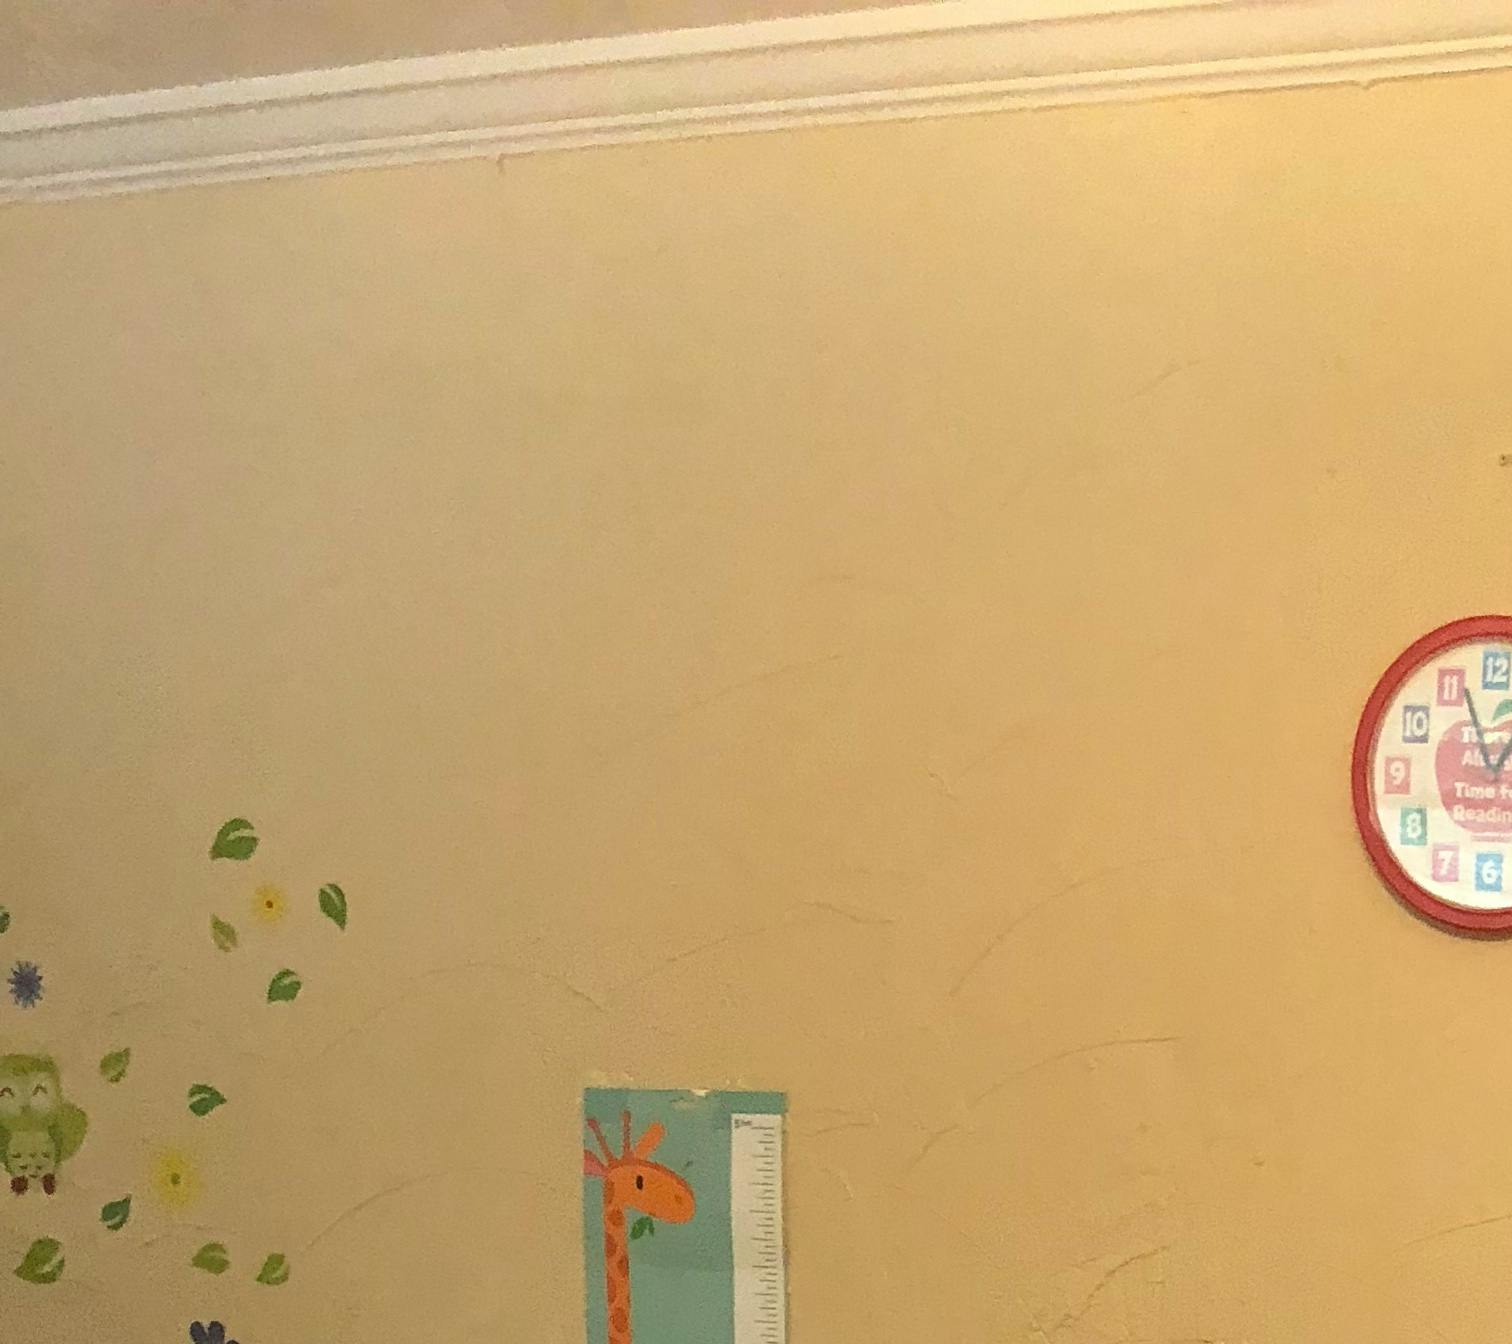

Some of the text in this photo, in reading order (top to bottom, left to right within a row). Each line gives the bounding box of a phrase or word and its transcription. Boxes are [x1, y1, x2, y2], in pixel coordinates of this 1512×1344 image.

[1486, 657, 1508, 683] 12
[1443, 676, 1458, 699] 11
[1405, 710, 1427, 736] 10
[1392, 761, 1405, 785] 9
[1454, 783, 1494, 799] Time
[1406, 814, 1422, 838] 8
[1440, 852, 1454, 875] 7
[1483, 862, 1497, 884] 6
